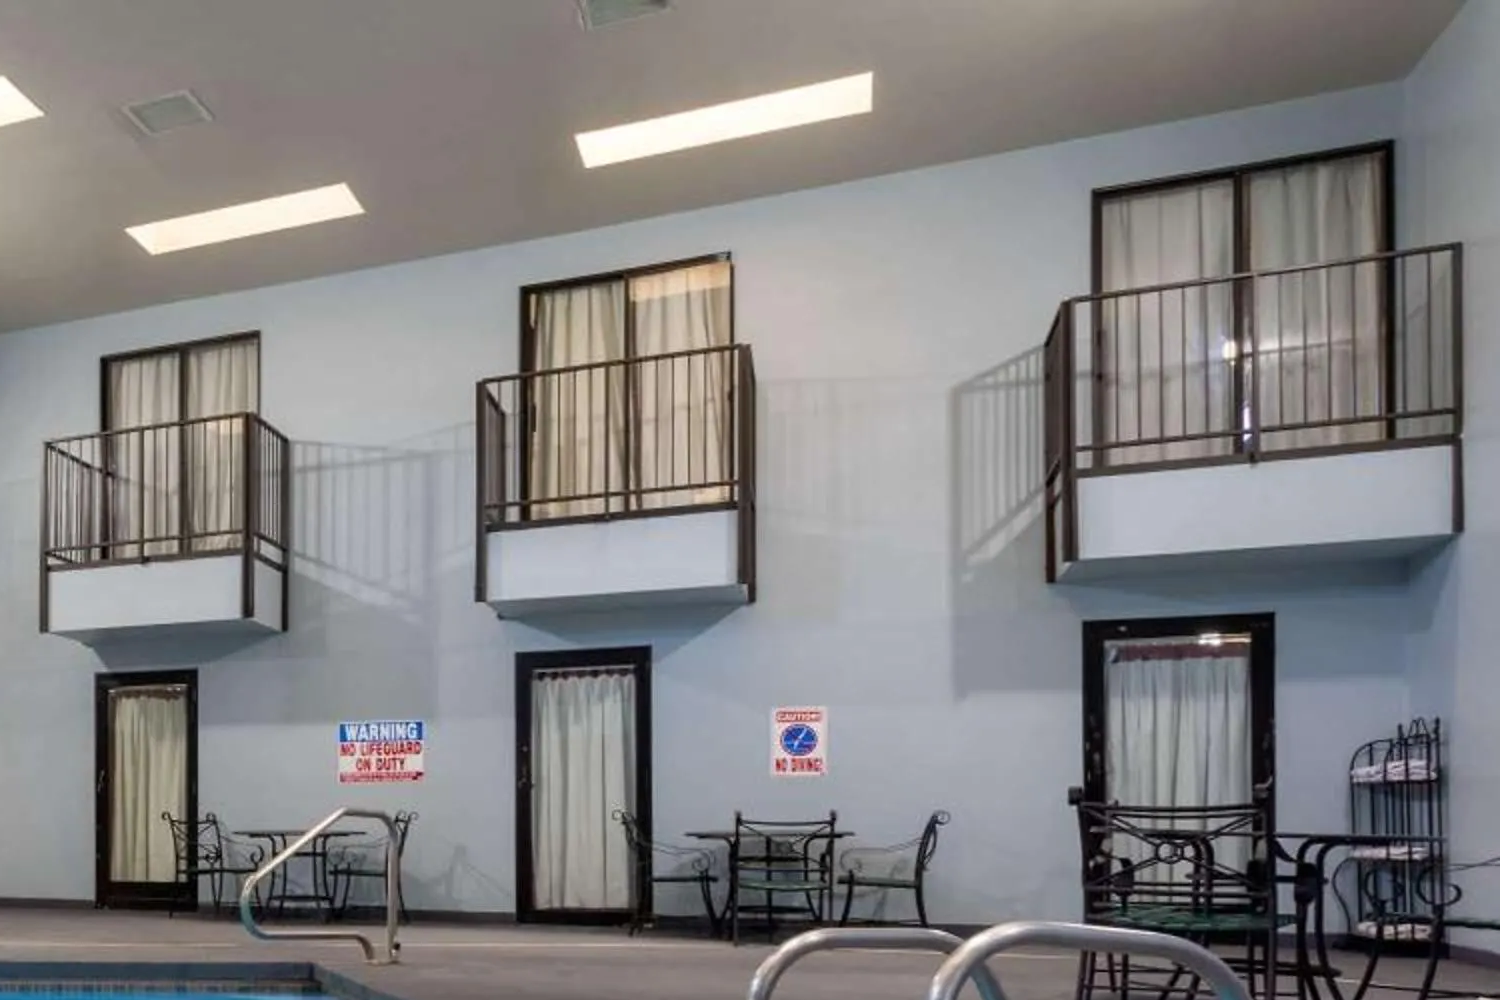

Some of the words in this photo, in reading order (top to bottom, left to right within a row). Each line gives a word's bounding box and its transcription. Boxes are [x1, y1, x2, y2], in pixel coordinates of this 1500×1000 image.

[345, 723, 417, 740] WARNING
[340, 743, 355, 756] NO
[360, 742, 421, 756] LIFEGUARD
[356, 758, 371, 771] ON
[376, 757, 404, 771] DUTY
[775, 758, 787, 772] NO
